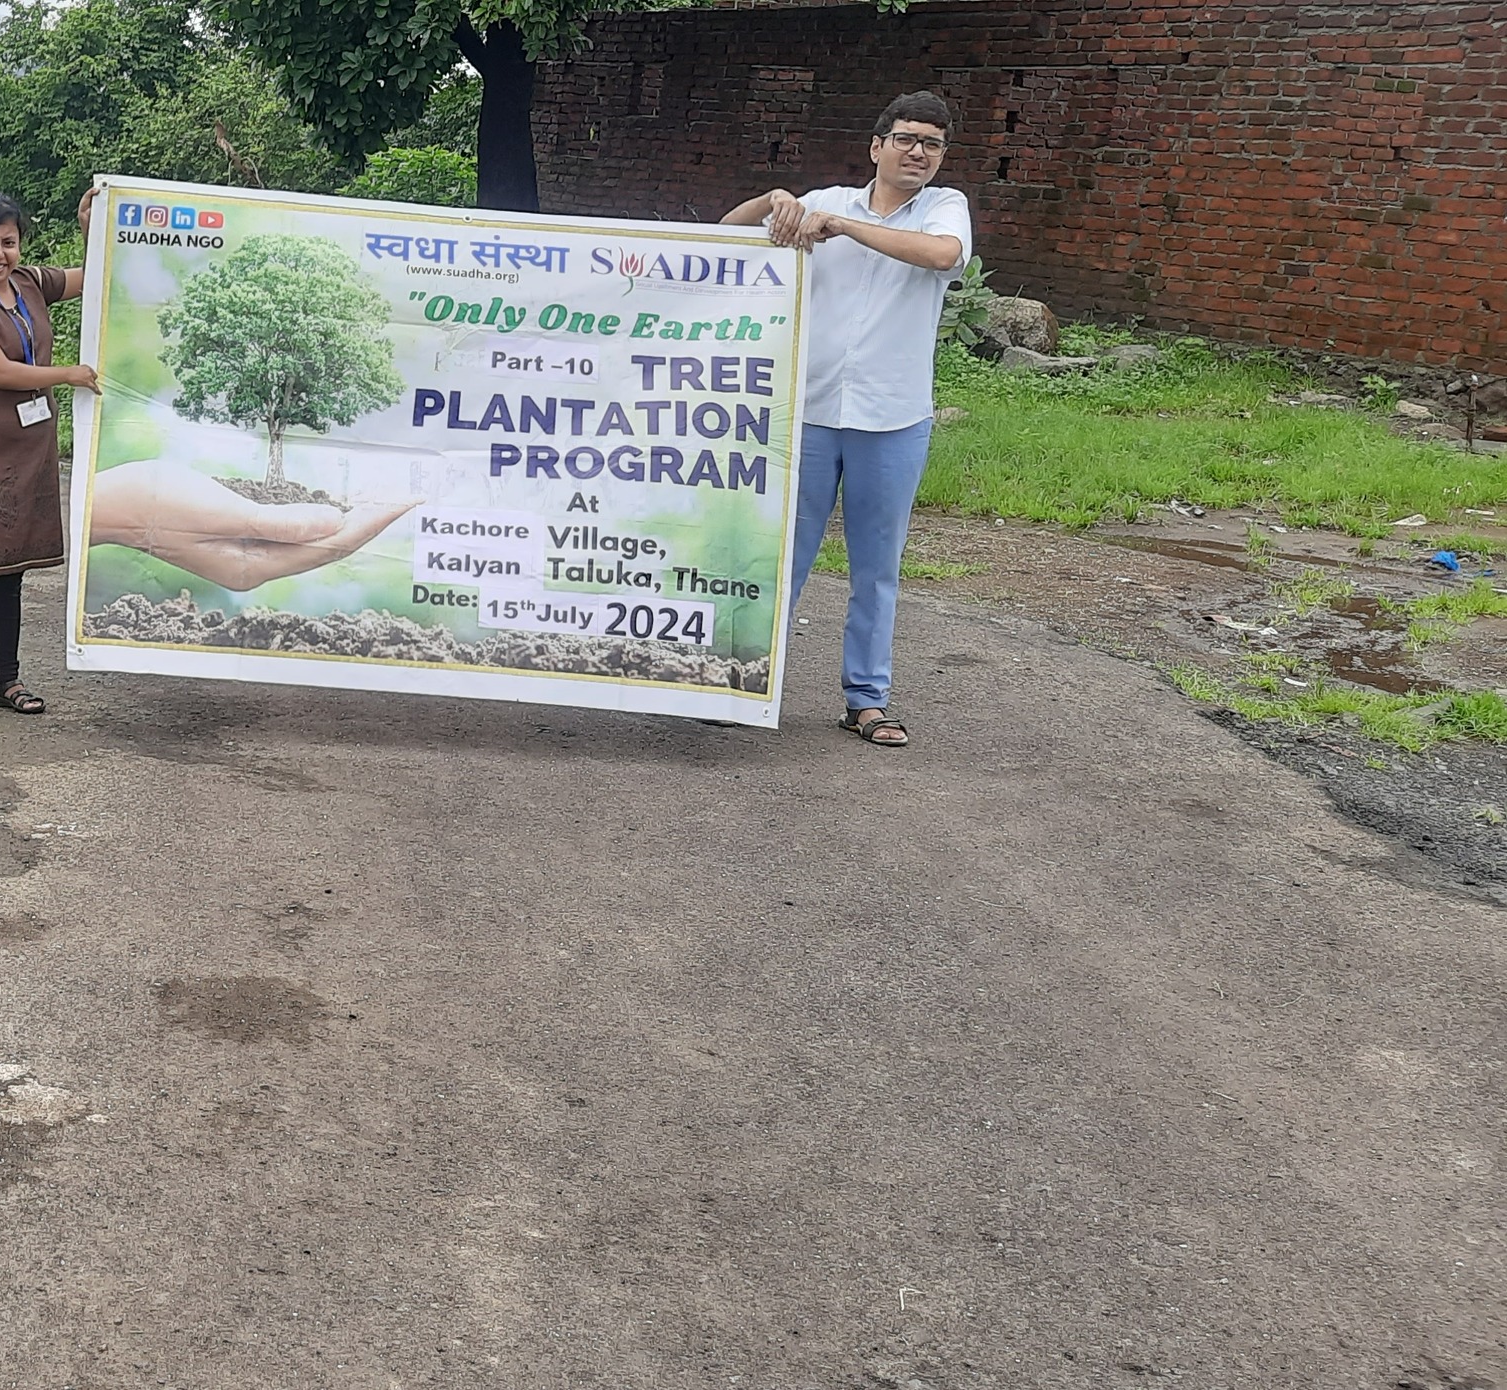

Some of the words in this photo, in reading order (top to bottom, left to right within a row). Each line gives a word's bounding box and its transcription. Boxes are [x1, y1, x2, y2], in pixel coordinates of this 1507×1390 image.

[117, 231, 182, 247] SUADHA
[187, 235, 224, 249] NGO
[365, 233, 458, 264] स्वधा
[470, 235, 570, 273] संस्था
[406, 264, 519, 284] (www.suadha.org)
[409, 290, 526, 332] "Only
[538, 304, 621, 335] One
[630, 312, 787, 342] Earth"
[491, 351, 543, 372] Part
[631, 355, 774, 397] TREE
[412, 388, 770, 446] PLANTATION
[489, 443, 767, 495] PROGRAM
[566, 492, 599, 514] At
[421, 517, 530, 540] Kachore
[547, 526, 666, 561] Village,
[427, 552, 521, 579] Kalyan
[547, 557, 662, 593] Taluka,
[672, 566, 761, 600] Thane
[411, 585, 479, 609] Date:
[605, 602, 706, 645] 2024
